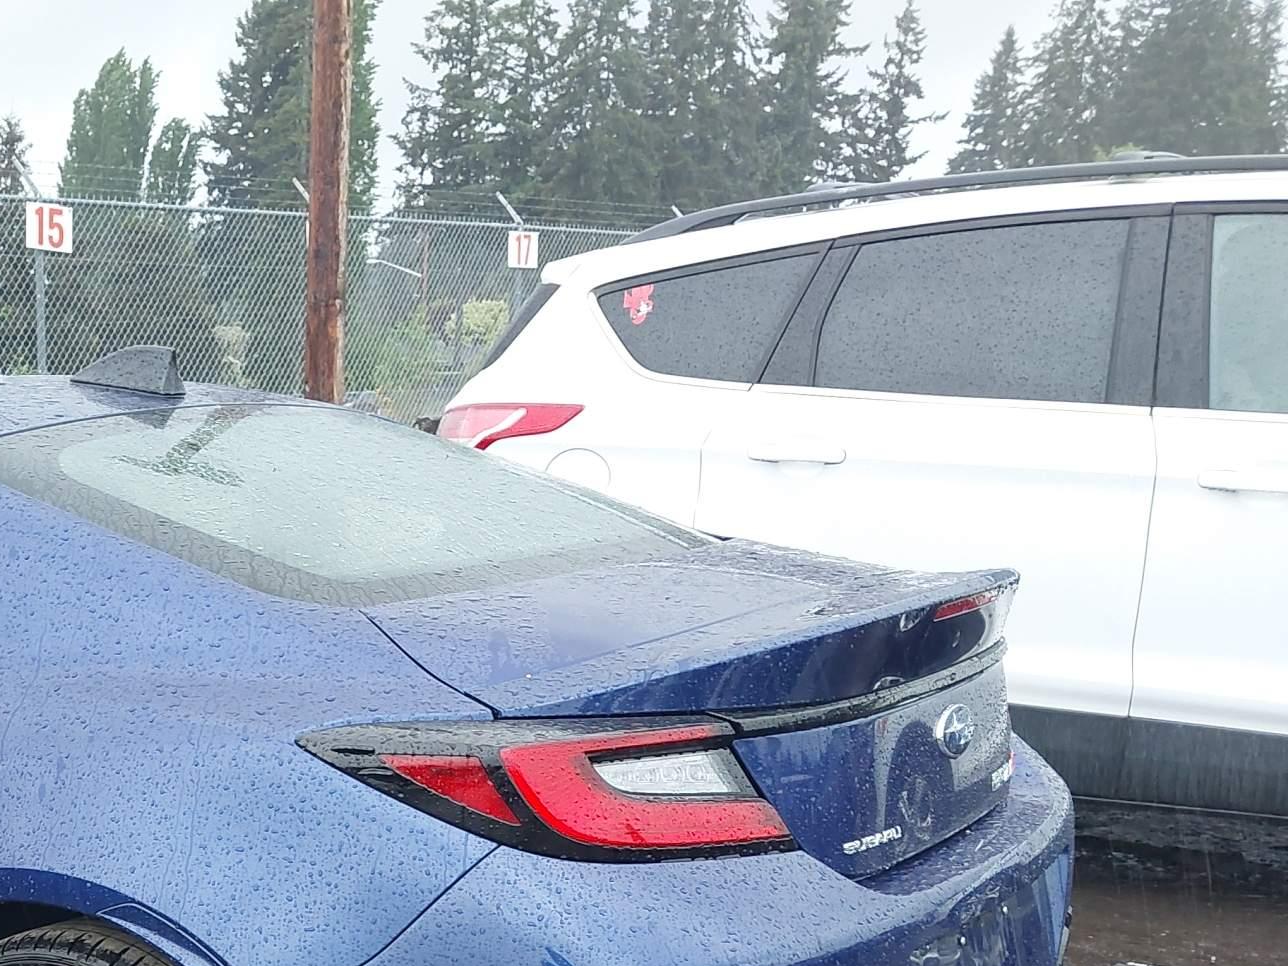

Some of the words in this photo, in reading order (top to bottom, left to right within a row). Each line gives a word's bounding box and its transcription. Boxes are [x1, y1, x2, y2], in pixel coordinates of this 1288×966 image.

[35, 206, 64, 249] 15
[515, 233, 532, 266] 17
[842, 825, 902, 855] SUBARU
